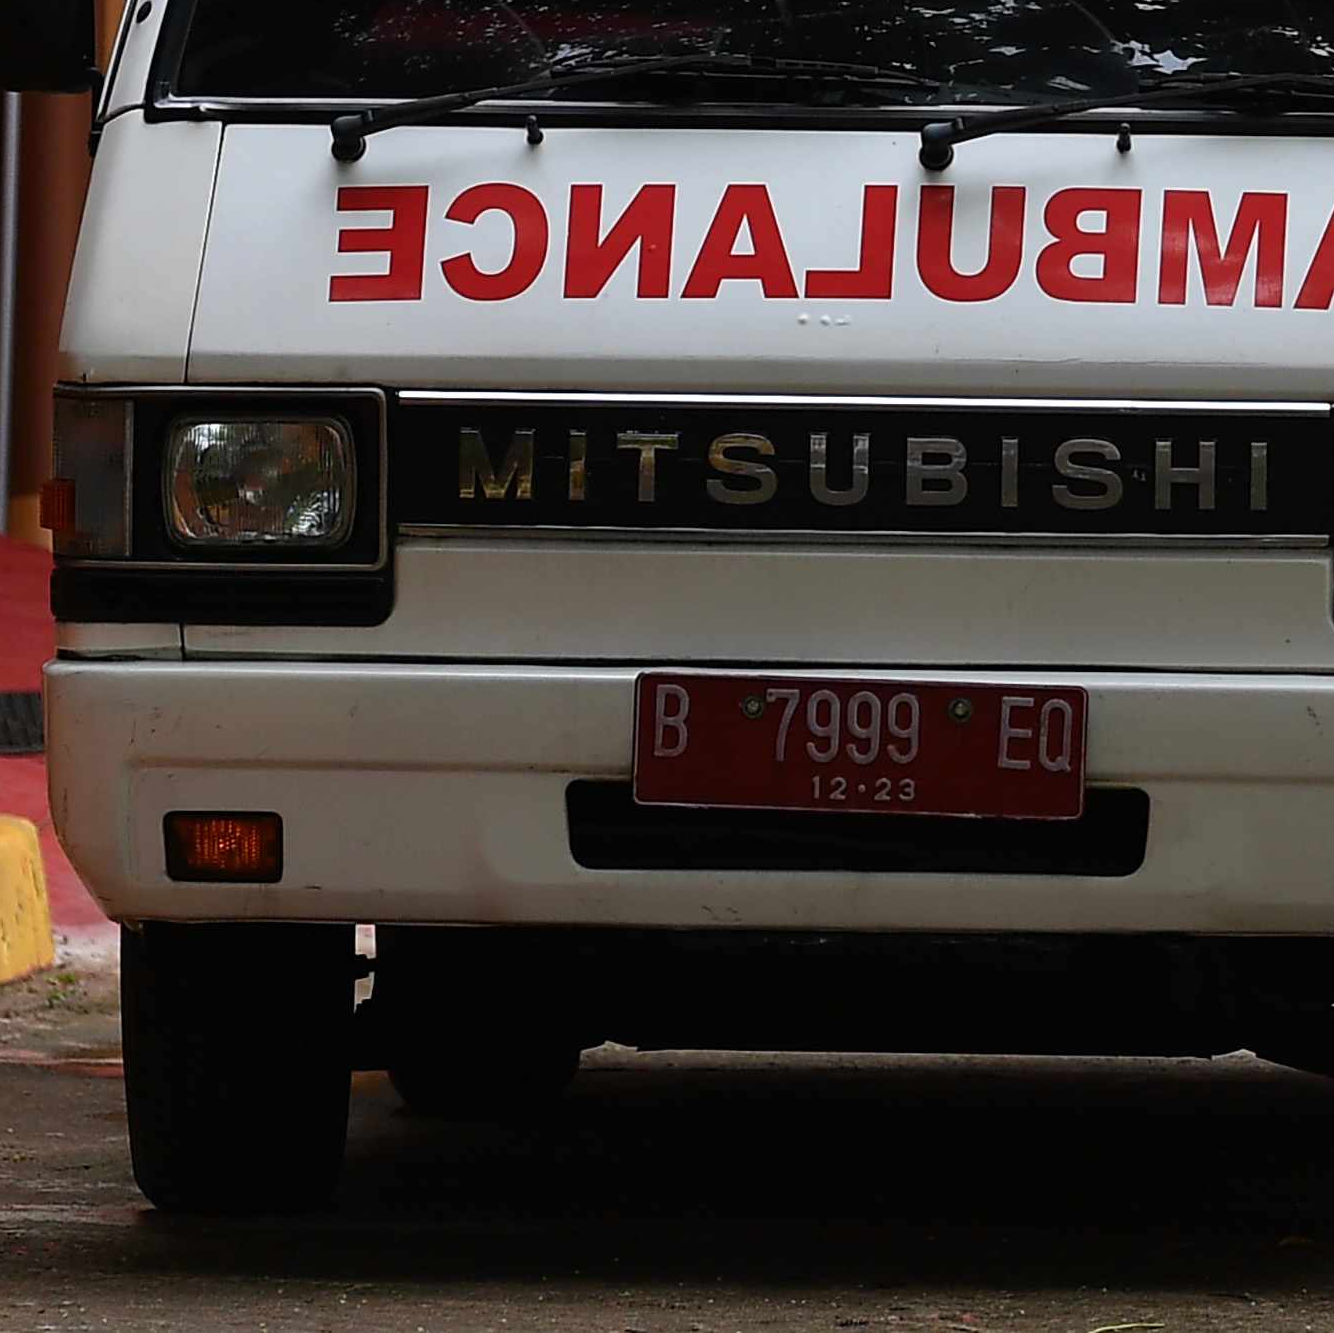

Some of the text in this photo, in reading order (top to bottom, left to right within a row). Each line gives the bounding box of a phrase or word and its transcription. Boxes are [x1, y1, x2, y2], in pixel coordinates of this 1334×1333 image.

[459, 427, 1268, 510] MITSUBISHI
[653, 683, 1074, 773] B 7999 EQ
